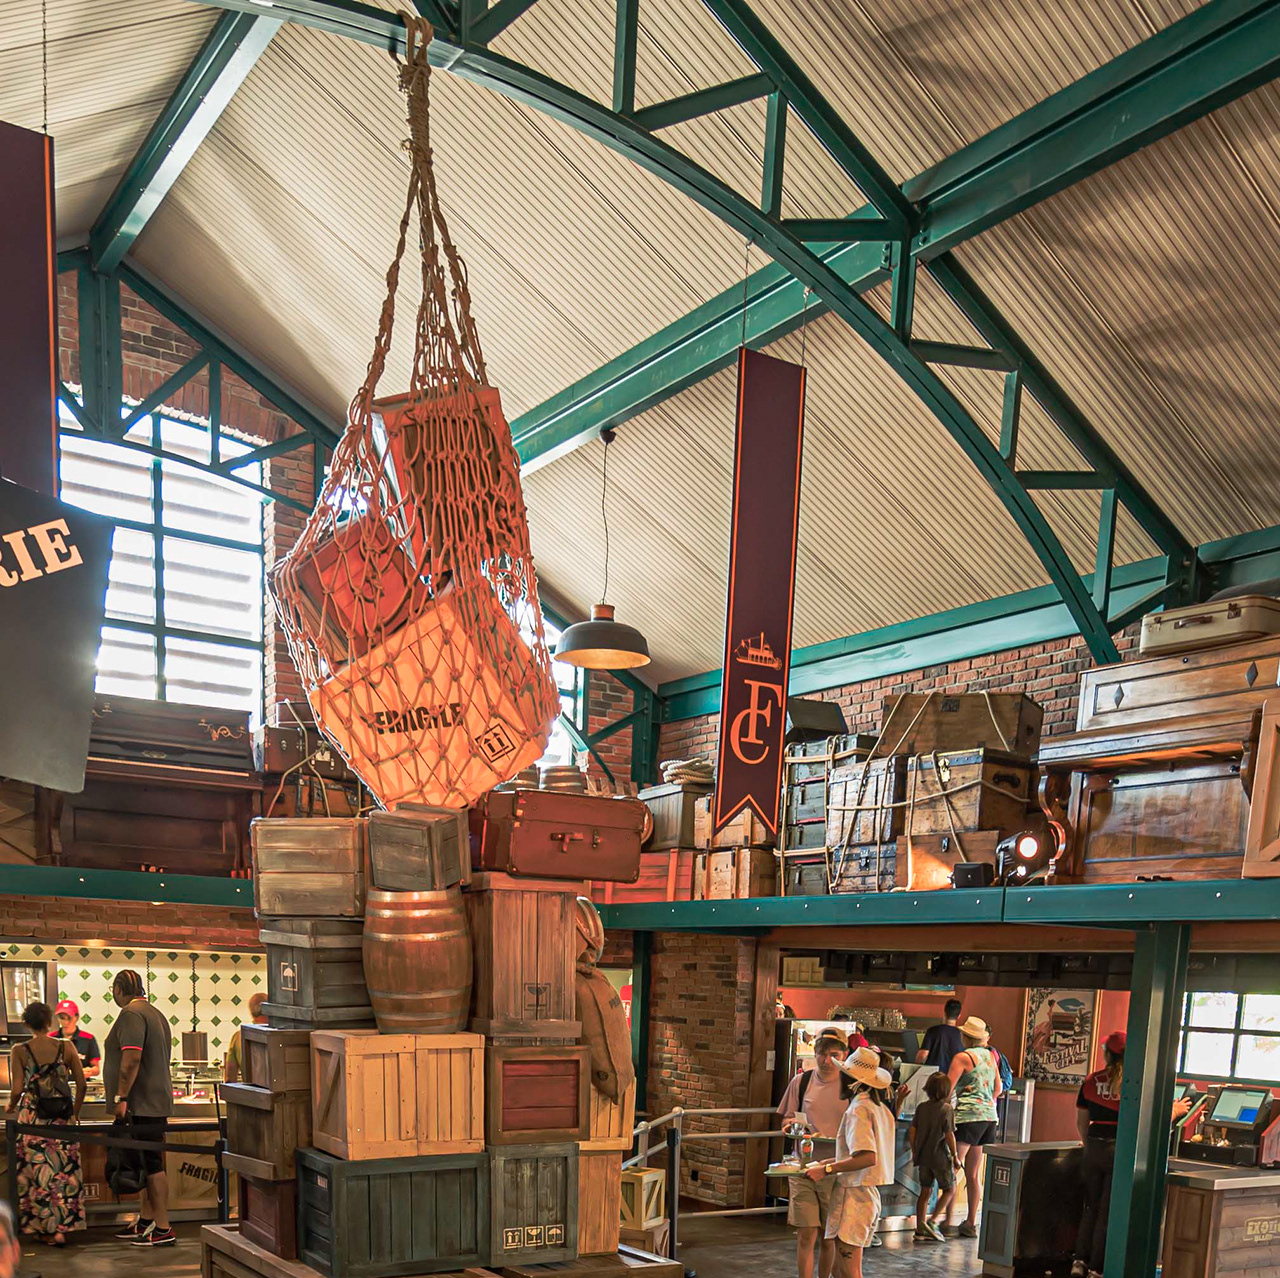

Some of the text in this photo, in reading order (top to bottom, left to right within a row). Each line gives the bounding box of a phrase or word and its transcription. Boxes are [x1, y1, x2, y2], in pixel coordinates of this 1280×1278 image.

[374, 703, 465, 735] FRAGILE
[1042, 1038, 1089, 1065] FESTIVAL
[179, 1161, 218, 1184] FRAGIL
